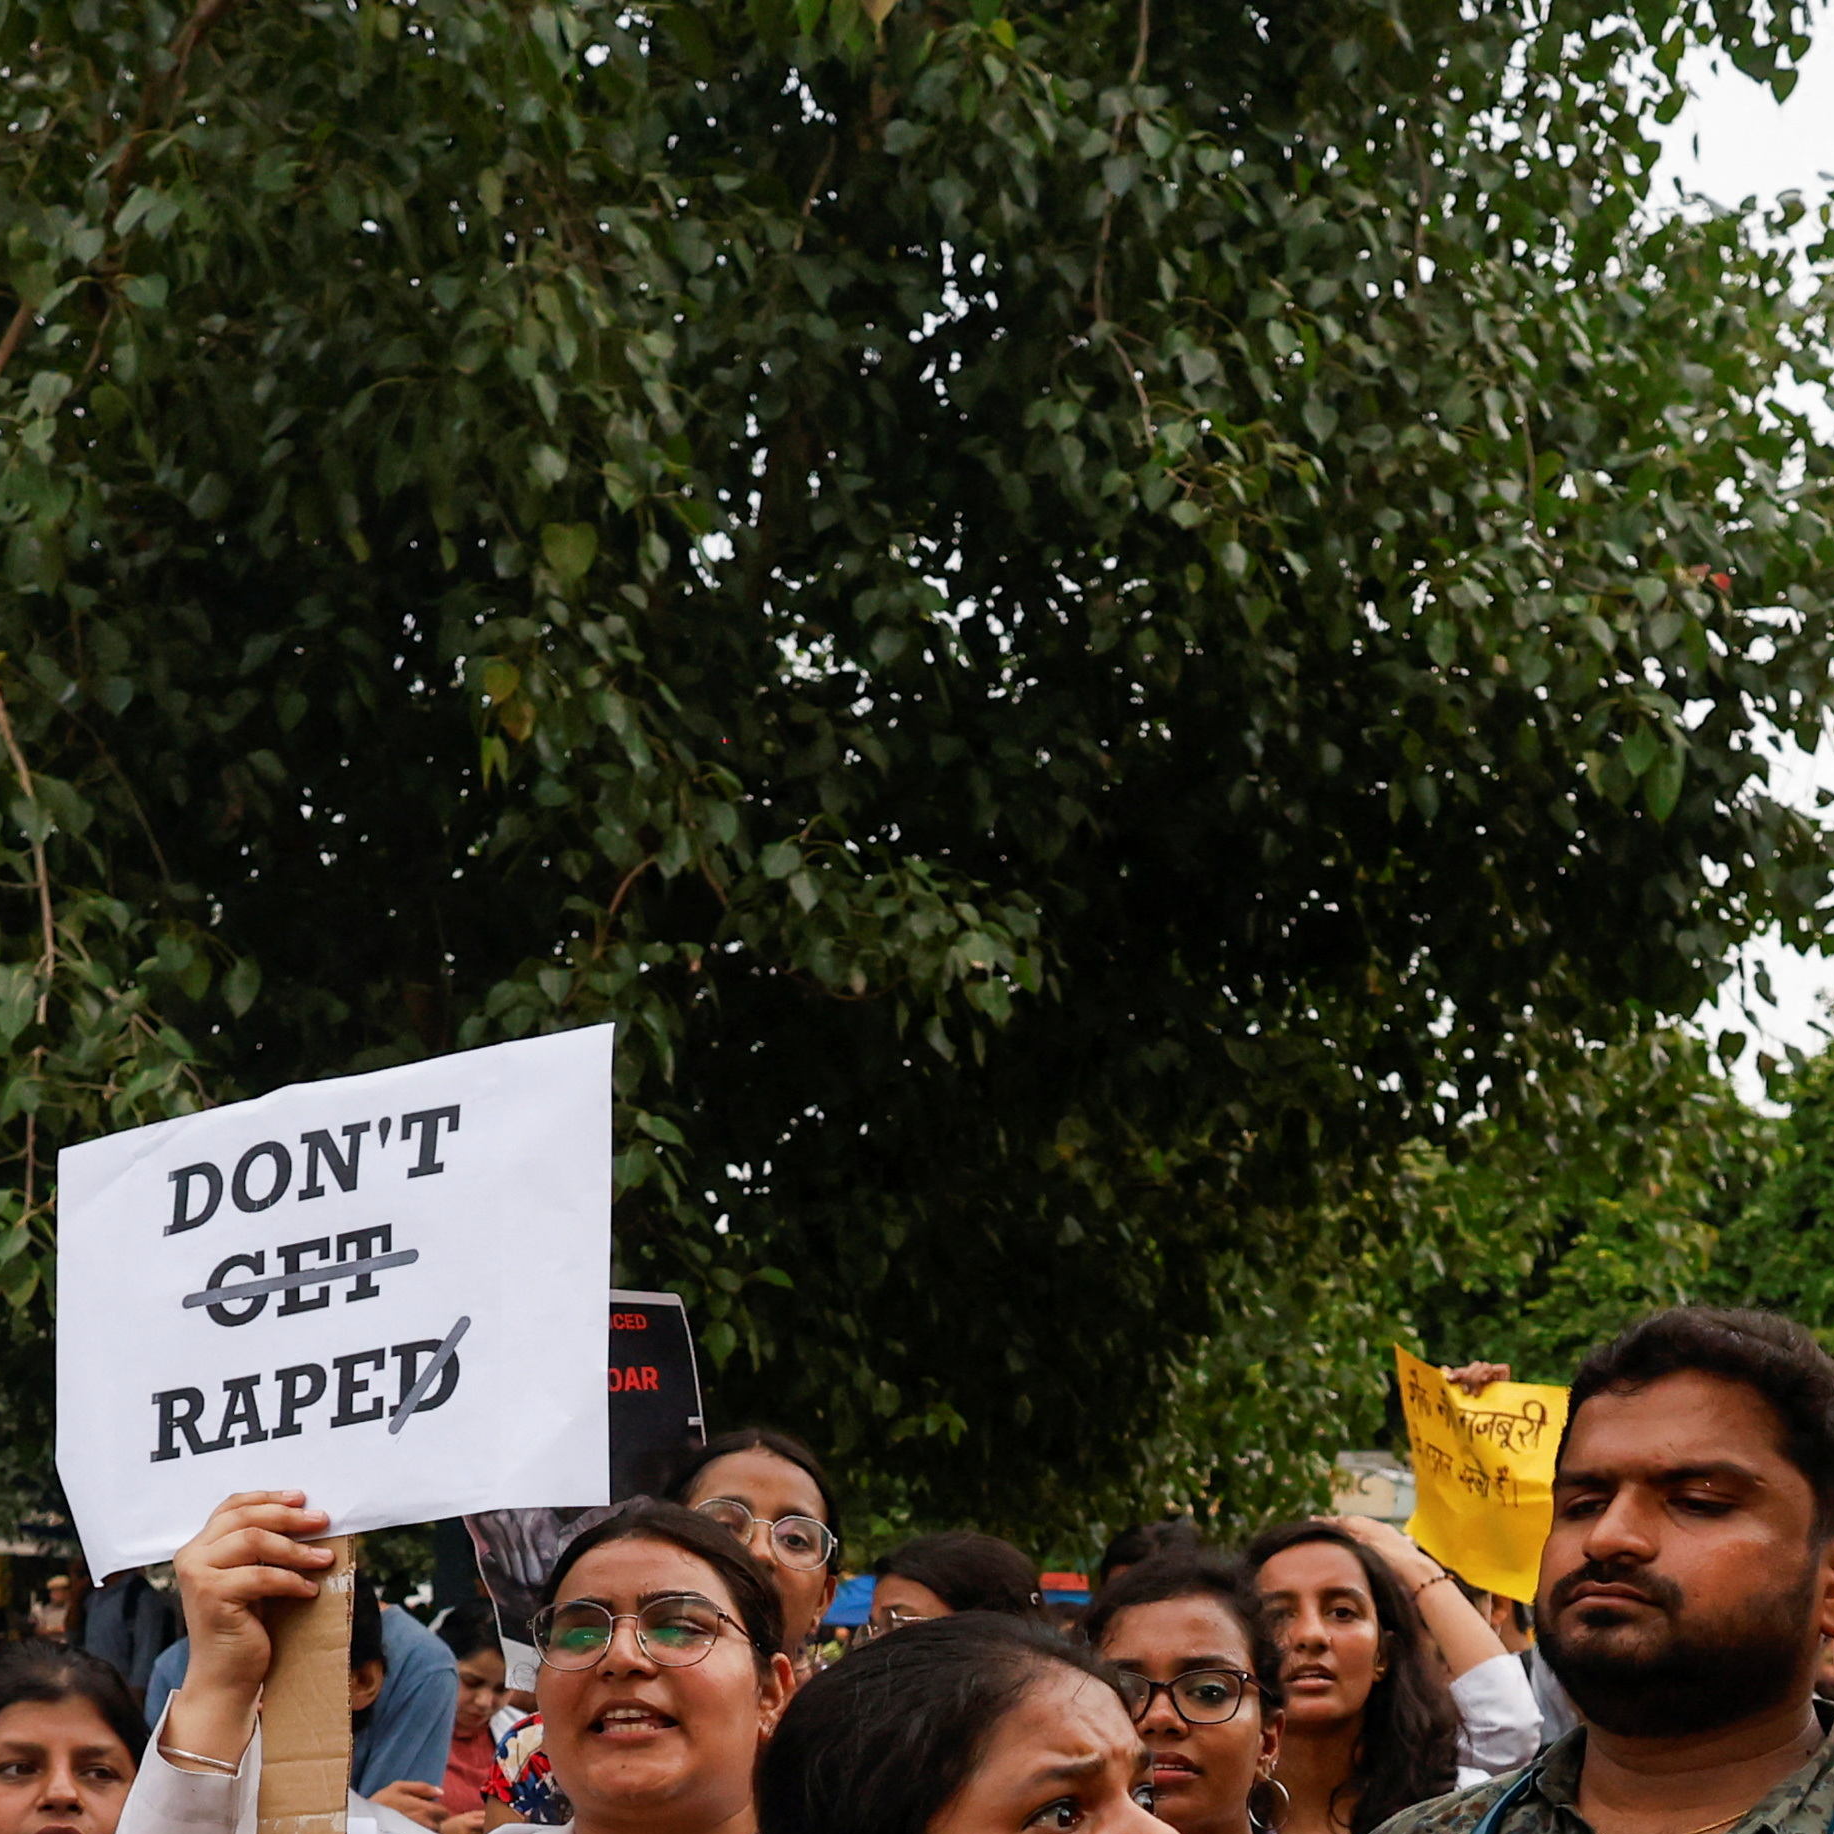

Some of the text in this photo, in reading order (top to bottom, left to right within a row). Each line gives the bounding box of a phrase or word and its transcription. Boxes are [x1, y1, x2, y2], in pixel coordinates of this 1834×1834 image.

[163, 1104, 460, 1237] DON'T
[205, 1223, 392, 1327] GET
[610, 1313, 649, 1330] CED
[150, 1337, 460, 1464] RAPED
[608, 1366, 659, 1392] OAR
